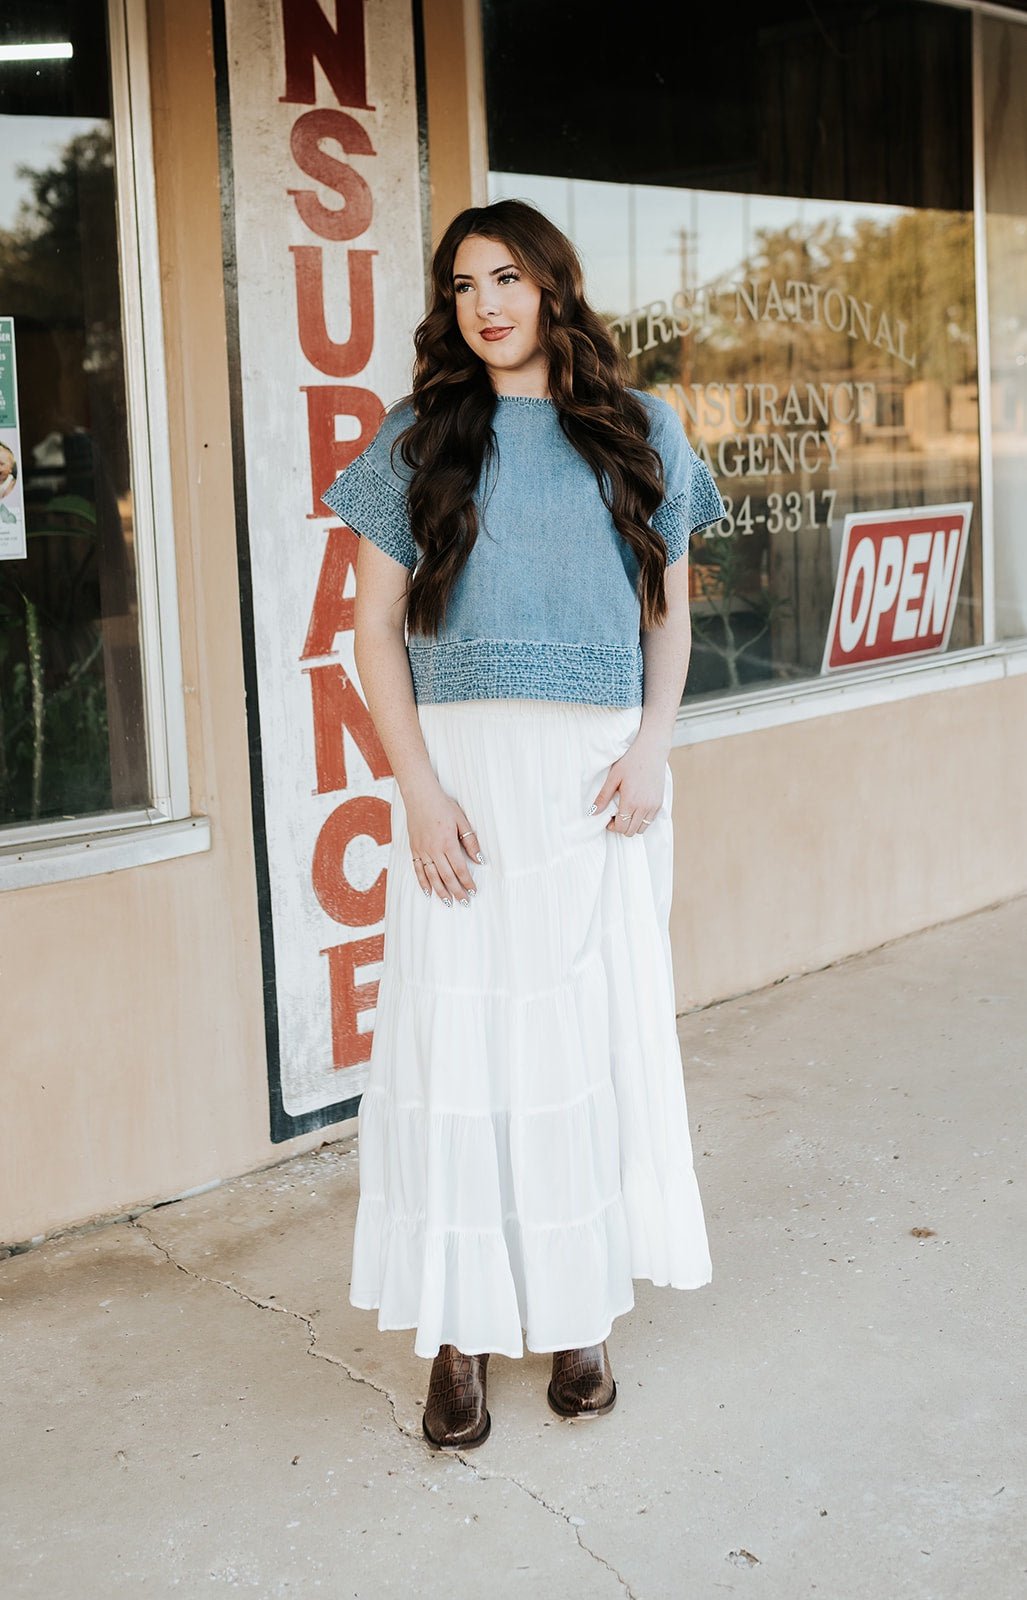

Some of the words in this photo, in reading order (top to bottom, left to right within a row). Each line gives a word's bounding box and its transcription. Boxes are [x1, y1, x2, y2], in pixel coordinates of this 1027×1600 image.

[732, 278, 917, 368] NATIONAL
[696, 431, 843, 478] AGENCY
[702, 489, 837, 539] 84-3317
[838, 529, 960, 653] OPEN
